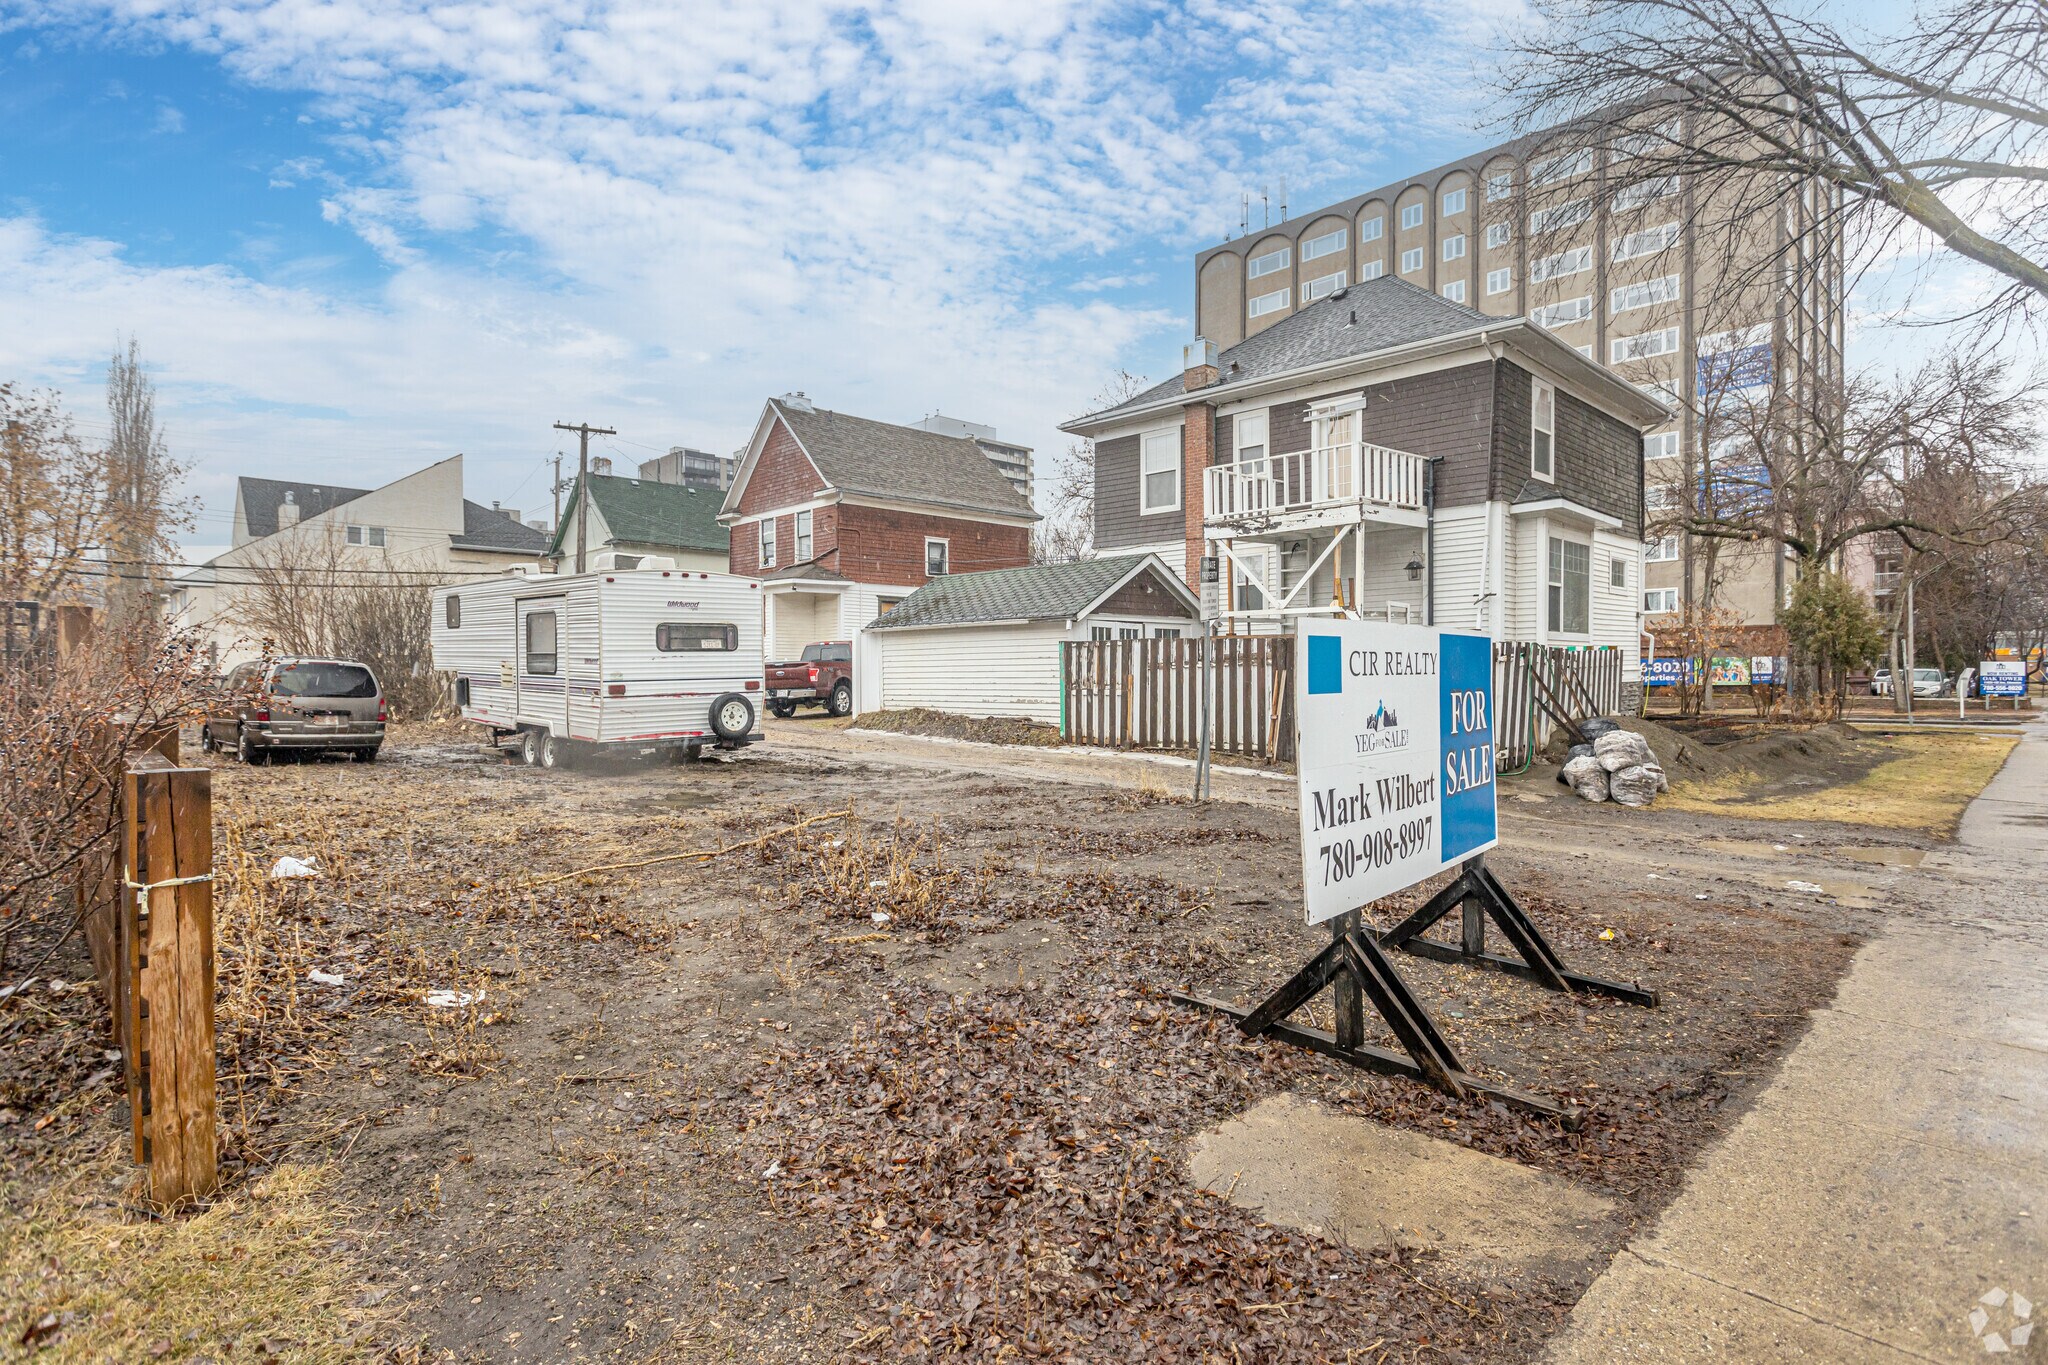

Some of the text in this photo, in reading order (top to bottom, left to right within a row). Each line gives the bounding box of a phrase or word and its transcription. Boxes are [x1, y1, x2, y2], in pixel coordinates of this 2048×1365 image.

[1349, 650, 1438, 677] CIR REALTY
[1450, 690, 1488, 735] FOR
[1446, 744, 1492, 797] SALE
[1312, 771, 1435, 832] Mark Wilbert
[1320, 816, 1433, 887] 780-908-8997
